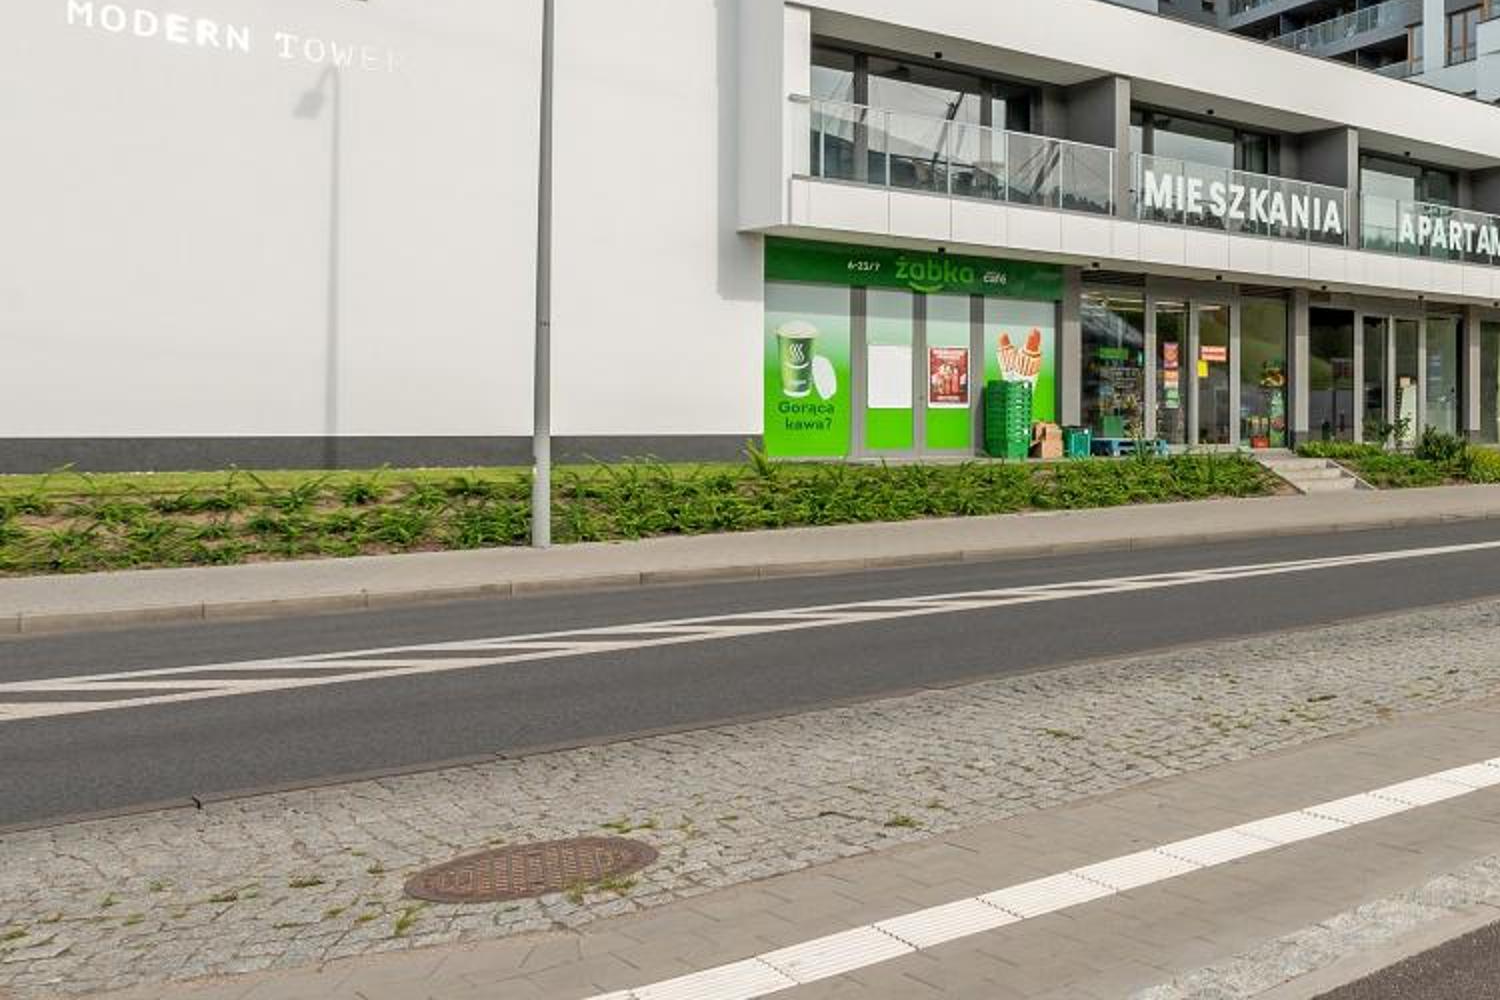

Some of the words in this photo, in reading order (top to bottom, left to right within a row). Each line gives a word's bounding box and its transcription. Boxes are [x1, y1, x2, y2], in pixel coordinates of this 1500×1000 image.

[1144, 169, 1343, 235] MIESZKANIA
[896, 256, 975, 283] żabka
[785, 417, 833, 431] kawa?
